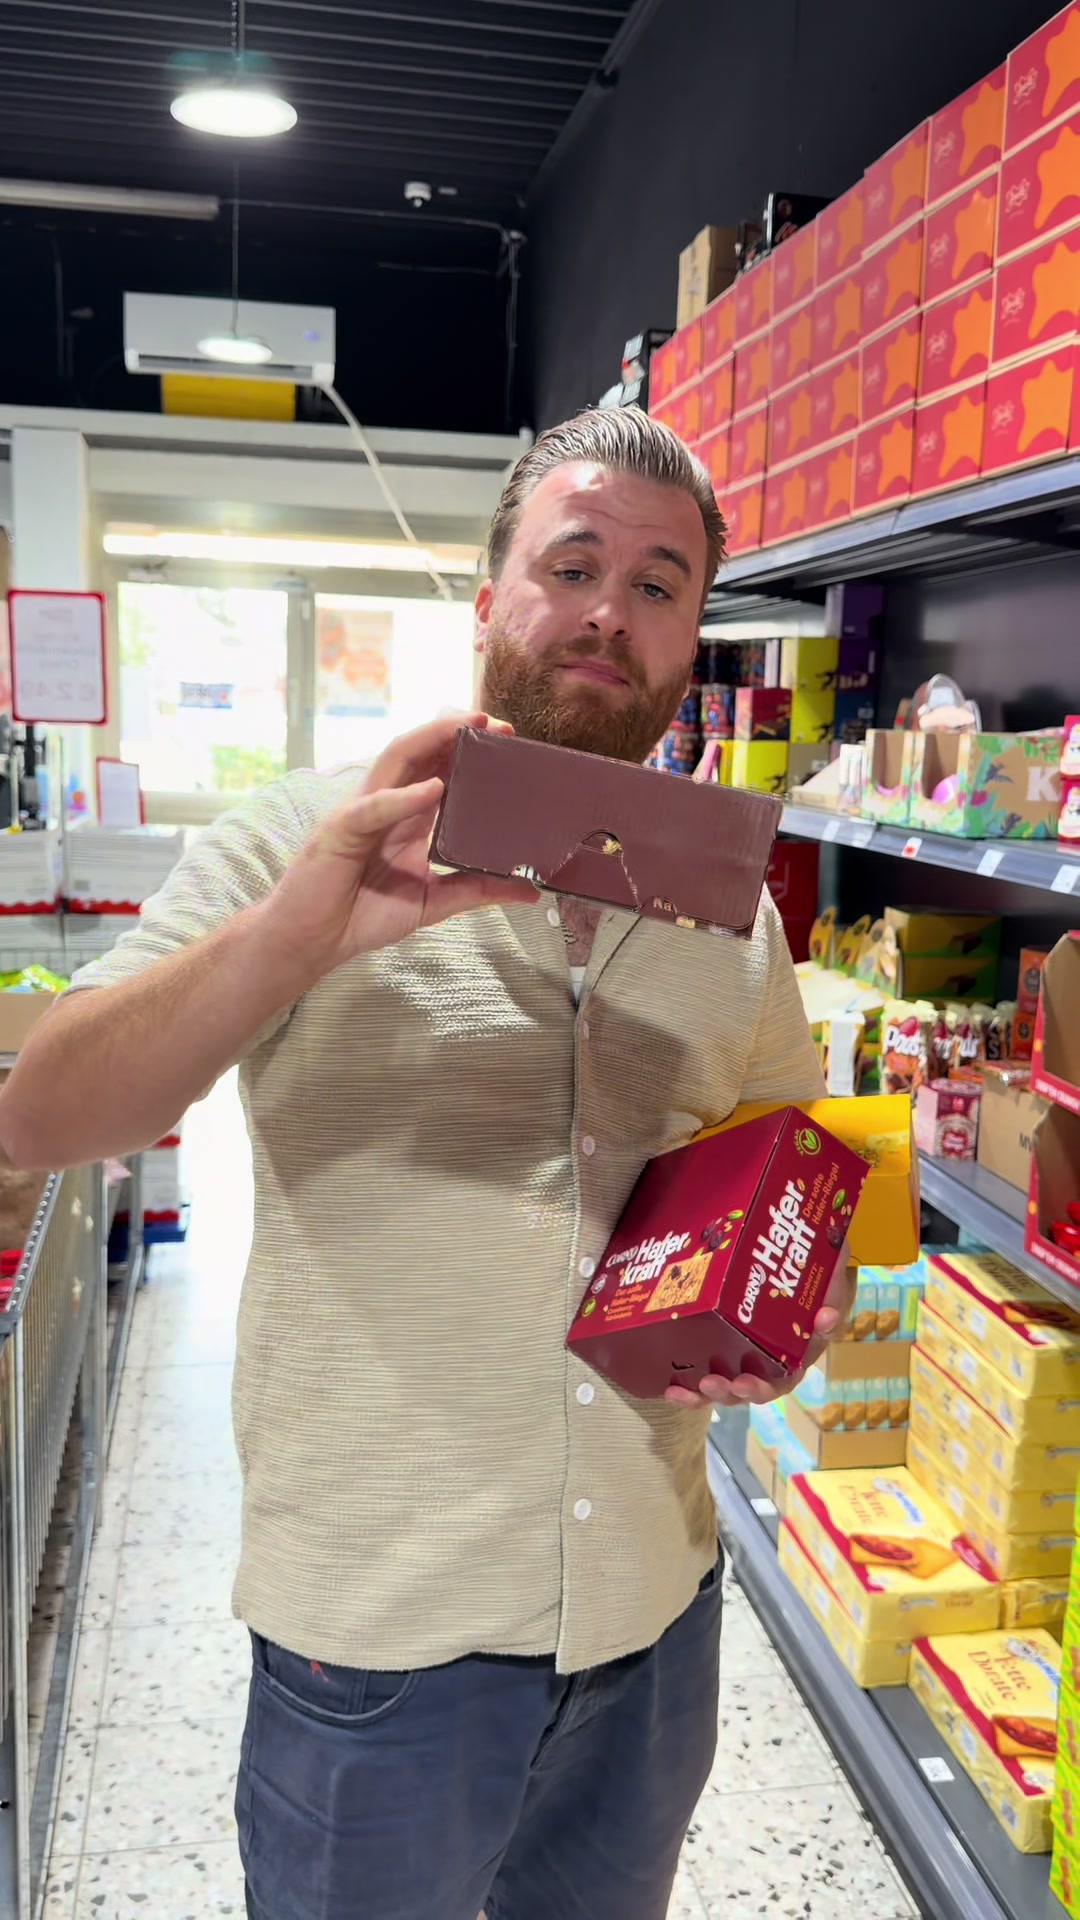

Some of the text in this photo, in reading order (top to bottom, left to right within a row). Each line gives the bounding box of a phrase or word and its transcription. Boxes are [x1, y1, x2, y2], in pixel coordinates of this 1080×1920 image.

[811, 1162, 840, 1225] Hafer-Riegel
[634, 1230, 690, 1265] Hafer
[737, 1179, 804, 1324] CORNY Hafer
[768, 1217, 816, 1298] kraft
